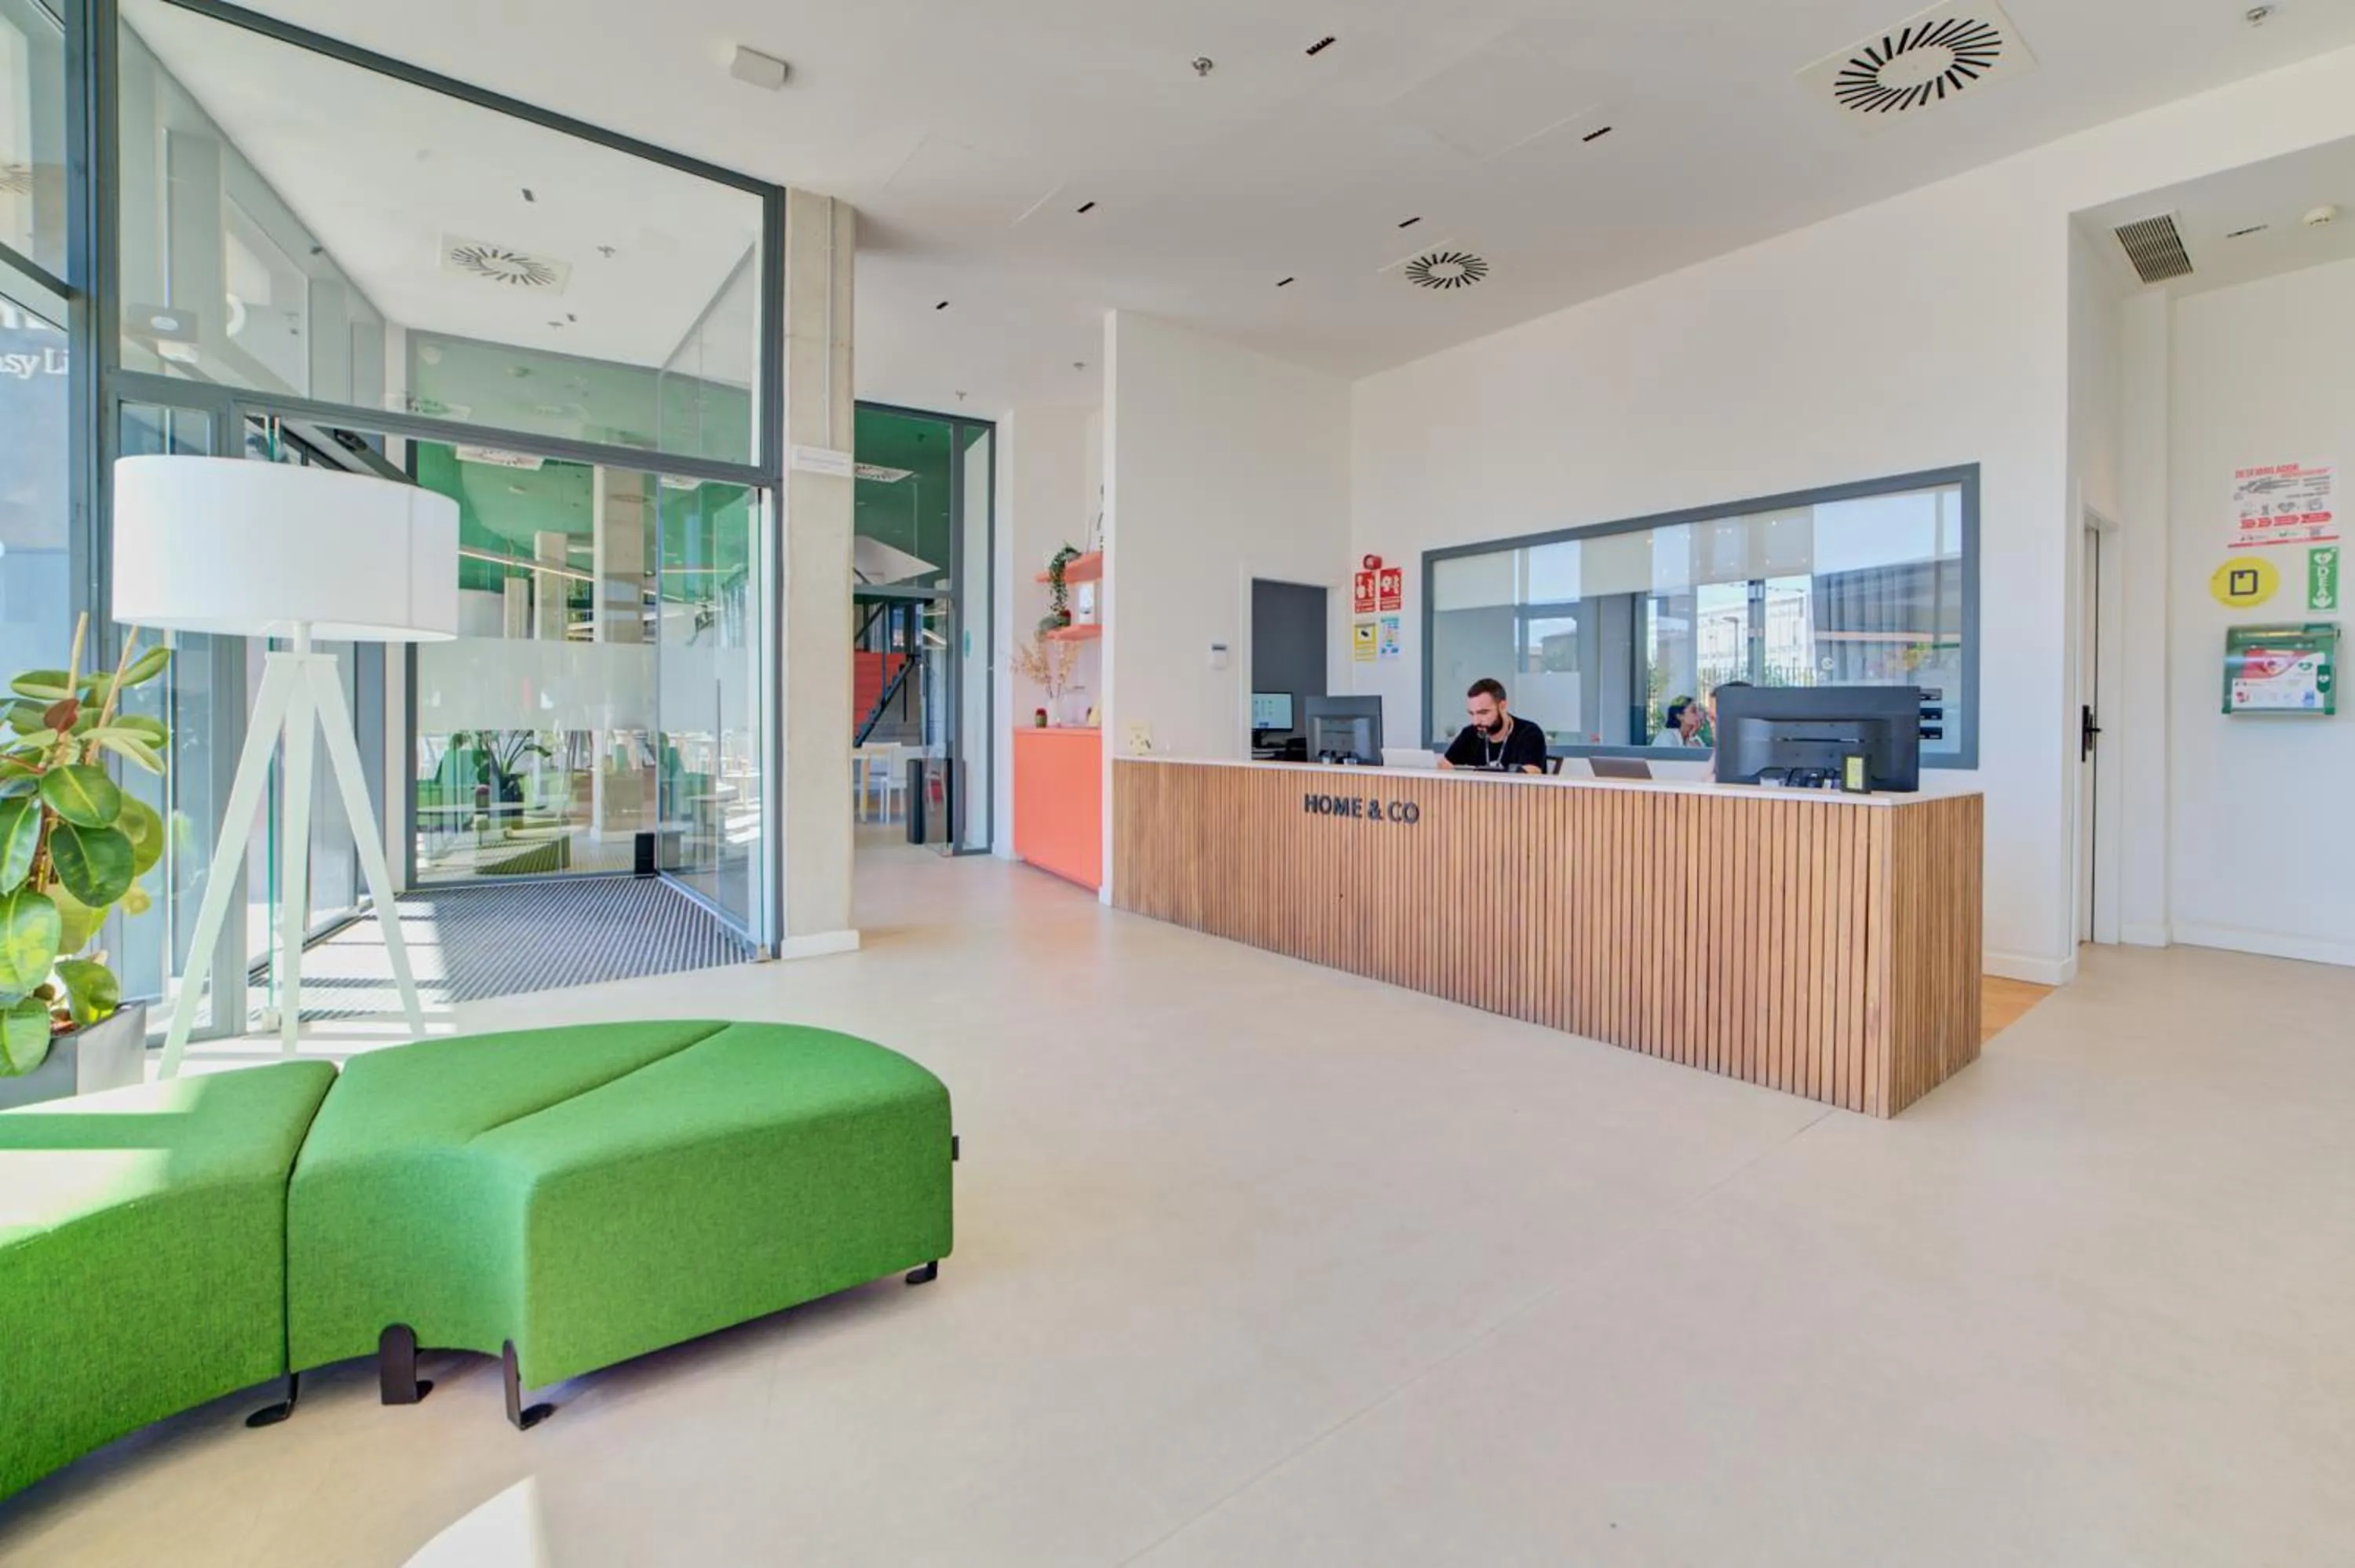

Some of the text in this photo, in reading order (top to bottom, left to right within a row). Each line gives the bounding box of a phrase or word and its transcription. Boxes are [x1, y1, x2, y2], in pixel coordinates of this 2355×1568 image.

[0, 354, 41, 380] sy
[2317, 565, 2330, 596] DEA
[1304, 793, 1420, 824] HOME & CO
